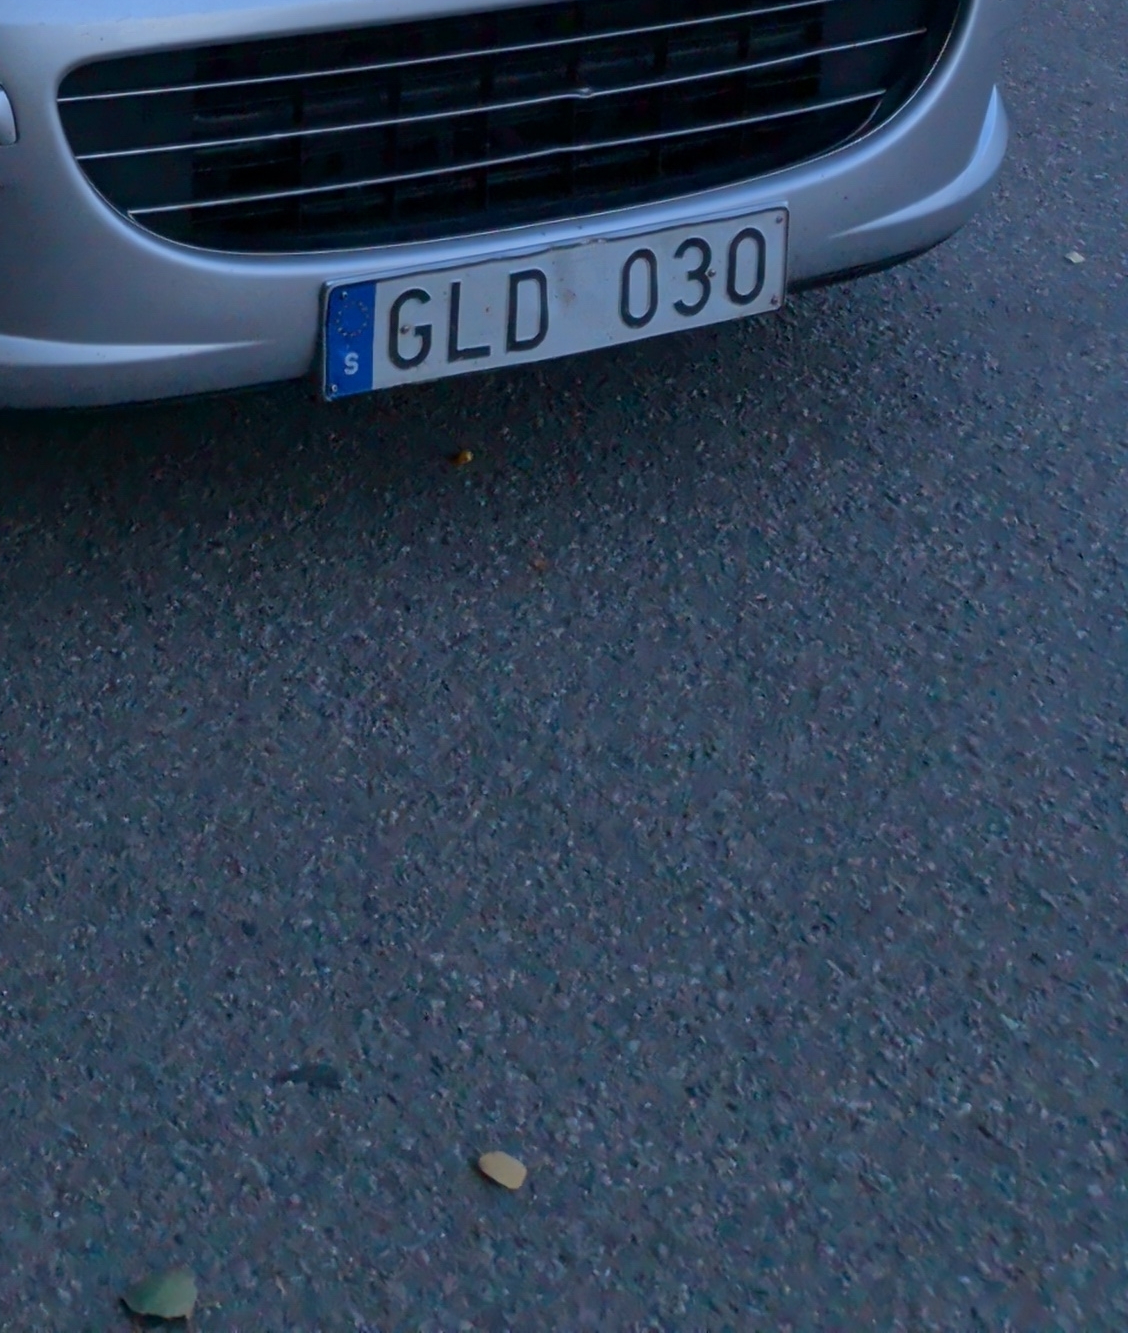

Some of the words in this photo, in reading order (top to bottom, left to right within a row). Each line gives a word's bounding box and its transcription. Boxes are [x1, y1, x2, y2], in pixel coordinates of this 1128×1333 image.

[388, 269, 550, 370] GLD
[620, 227, 766, 329] 030
[343, 352, 360, 376] S
